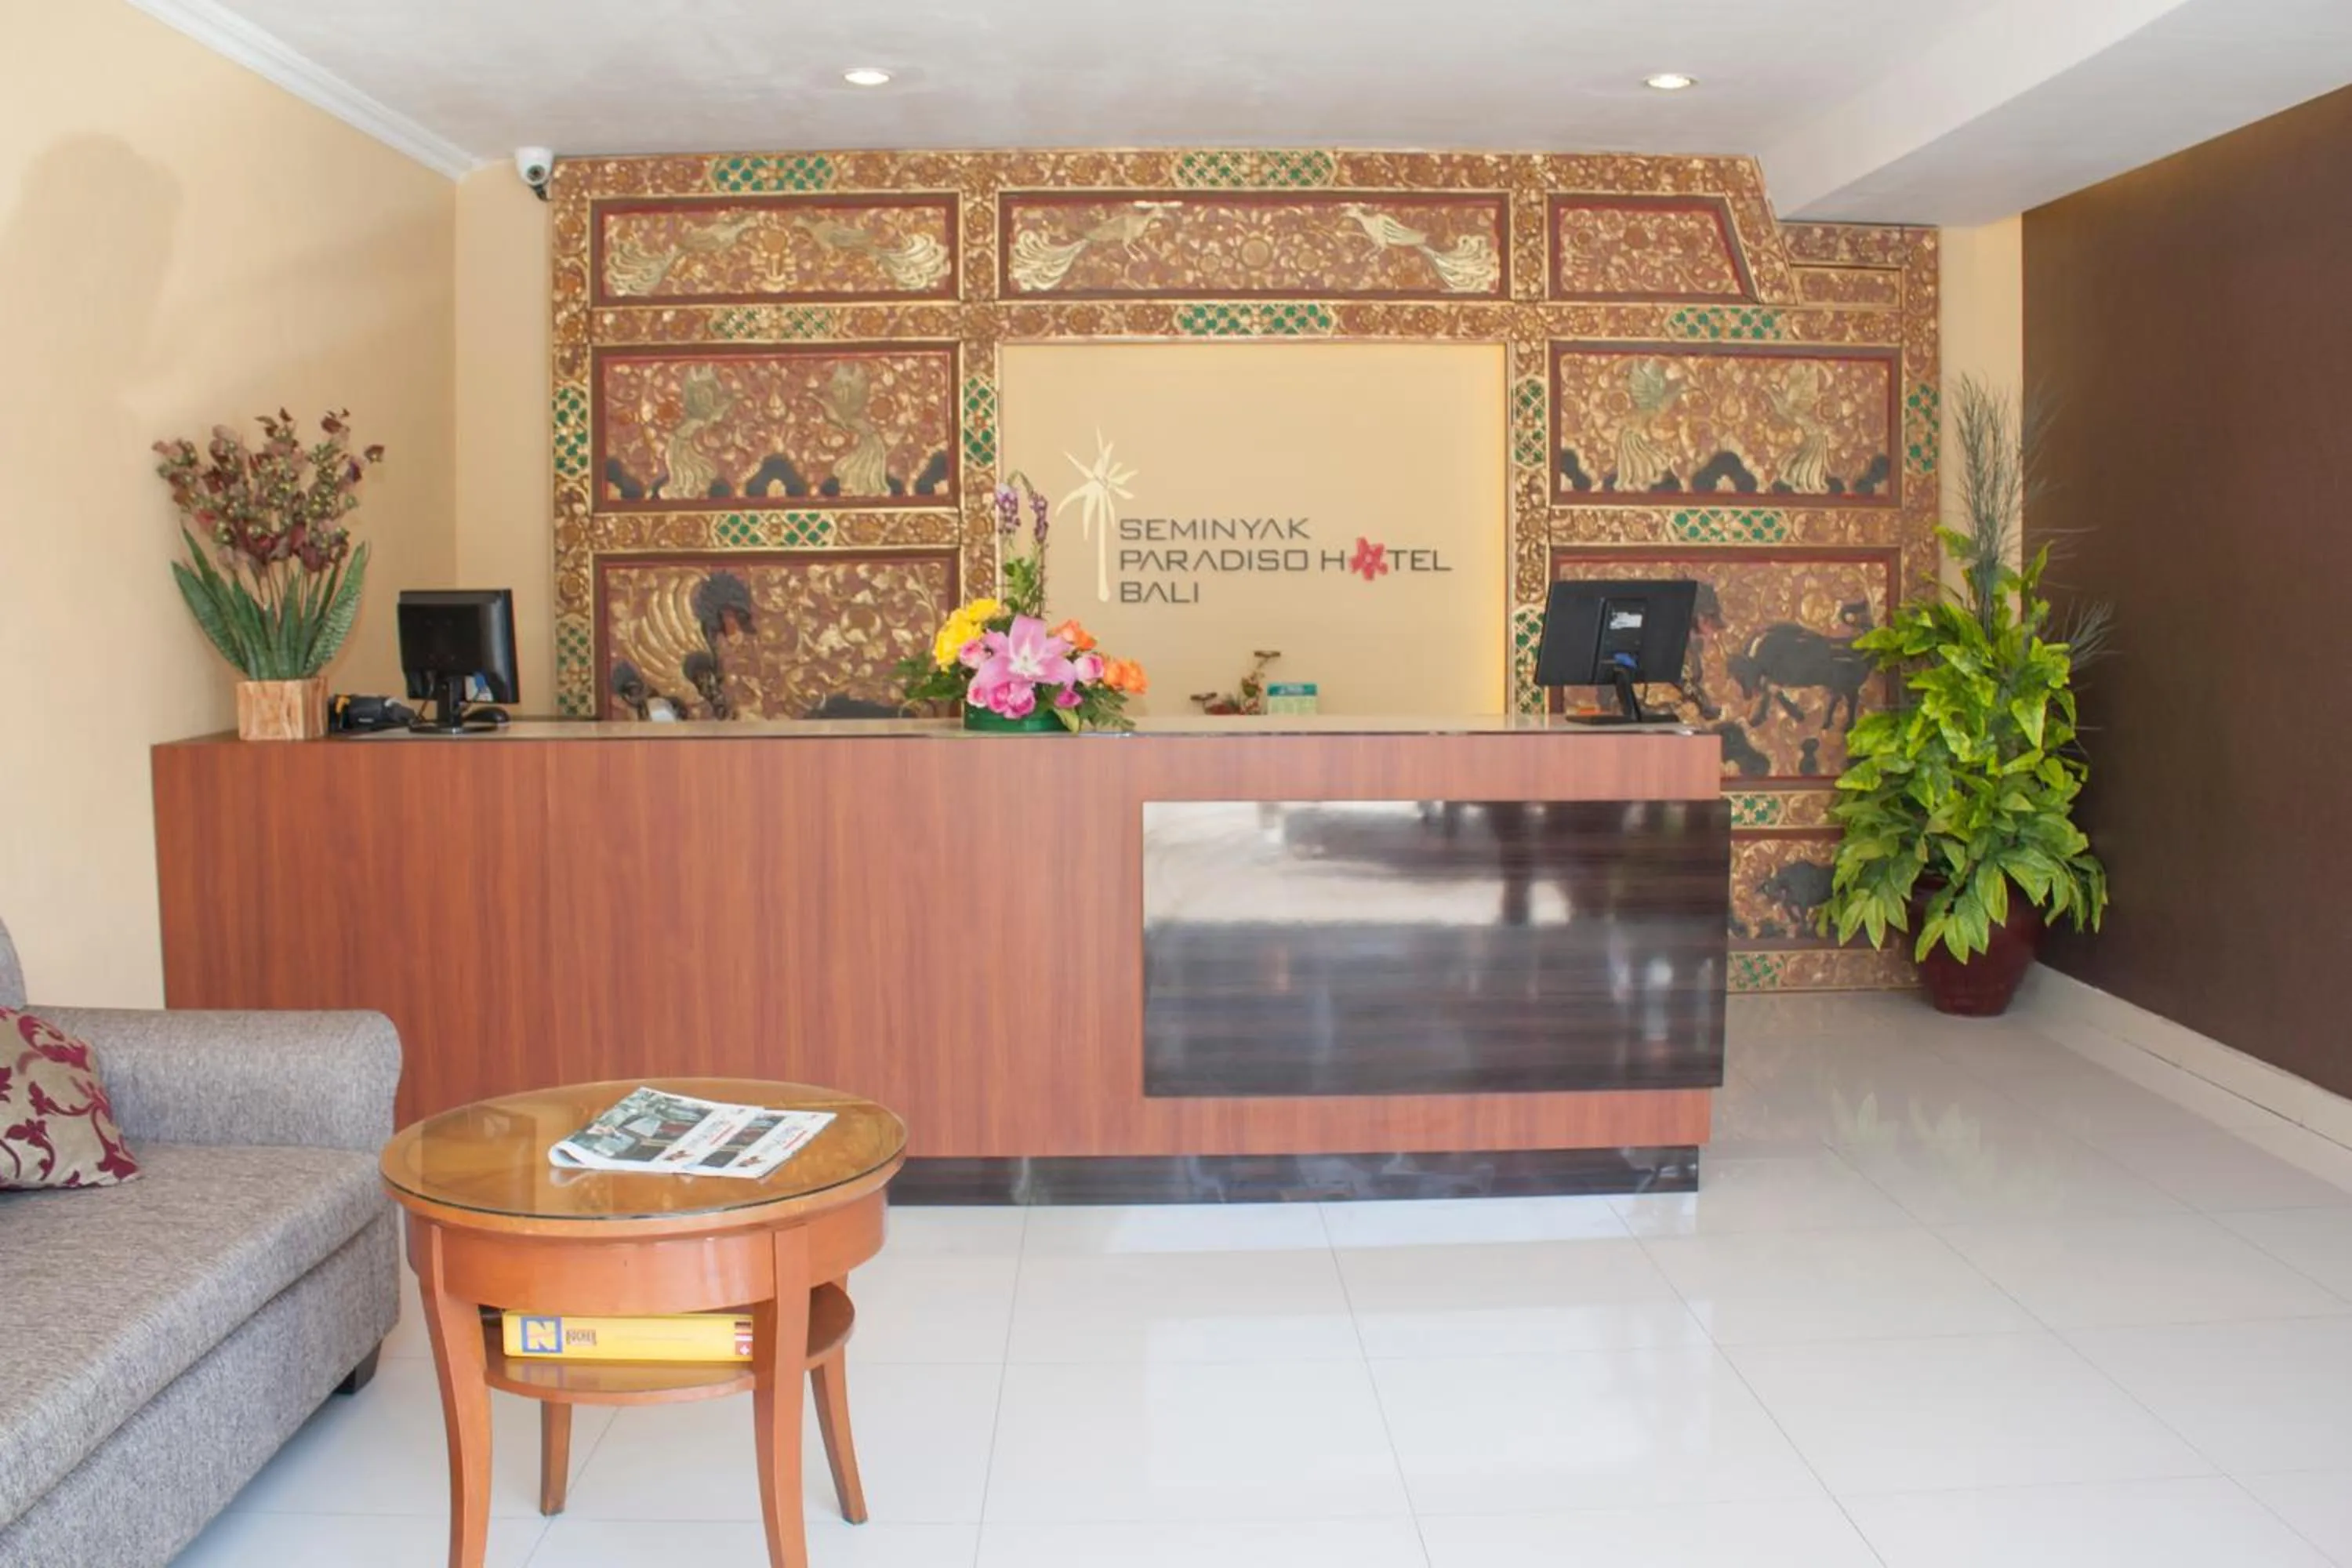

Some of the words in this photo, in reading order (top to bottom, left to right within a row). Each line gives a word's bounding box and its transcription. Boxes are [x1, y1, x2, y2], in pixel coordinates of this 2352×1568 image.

[1120, 518, 1310, 540] SEMINYAK
[1120, 550, 1308, 571] PARADISO
[1120, 582, 1198, 603] BALI
